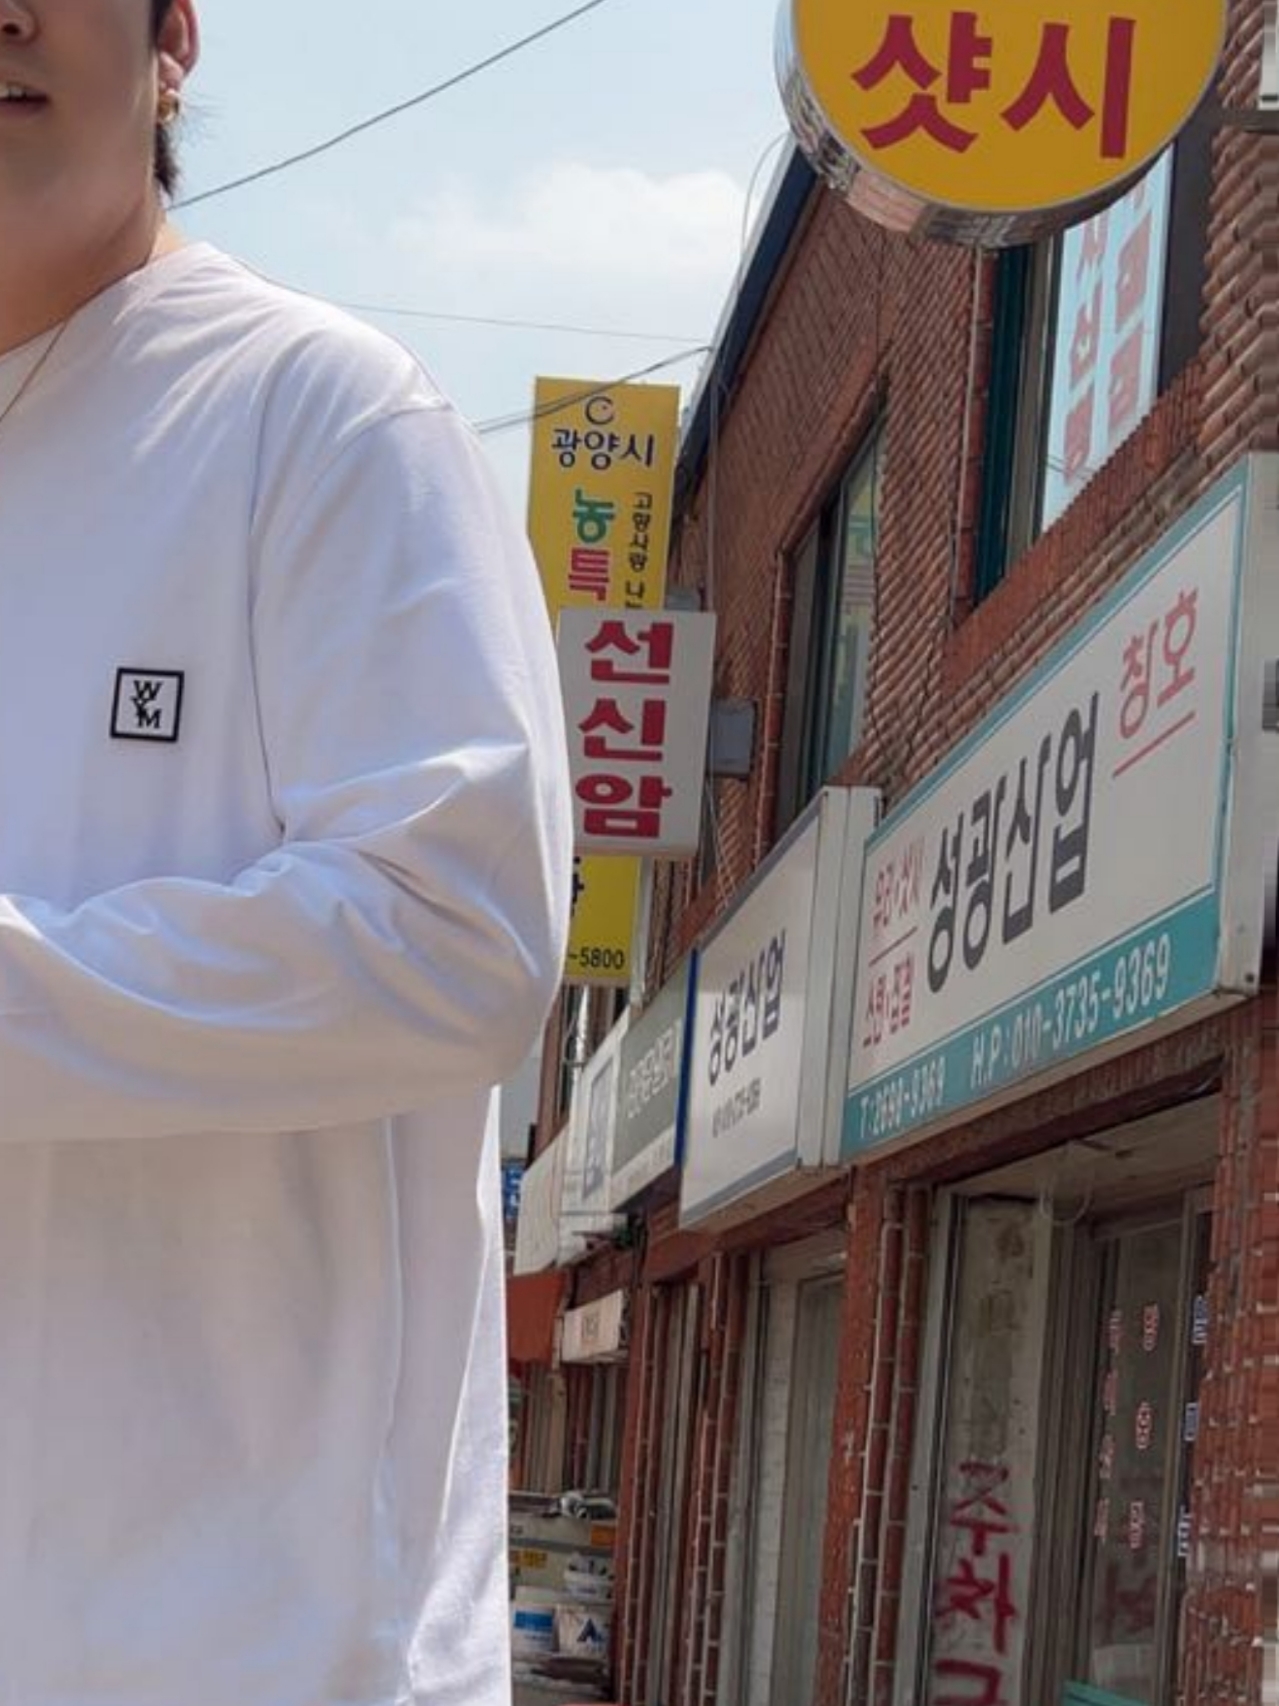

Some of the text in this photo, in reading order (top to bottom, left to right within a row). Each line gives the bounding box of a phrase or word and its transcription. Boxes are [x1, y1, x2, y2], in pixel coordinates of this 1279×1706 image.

[851, 10, 1136, 158] 샷시
[551, 428, 654, 470] 광양시
[575, 620, 673, 839] 선신암
